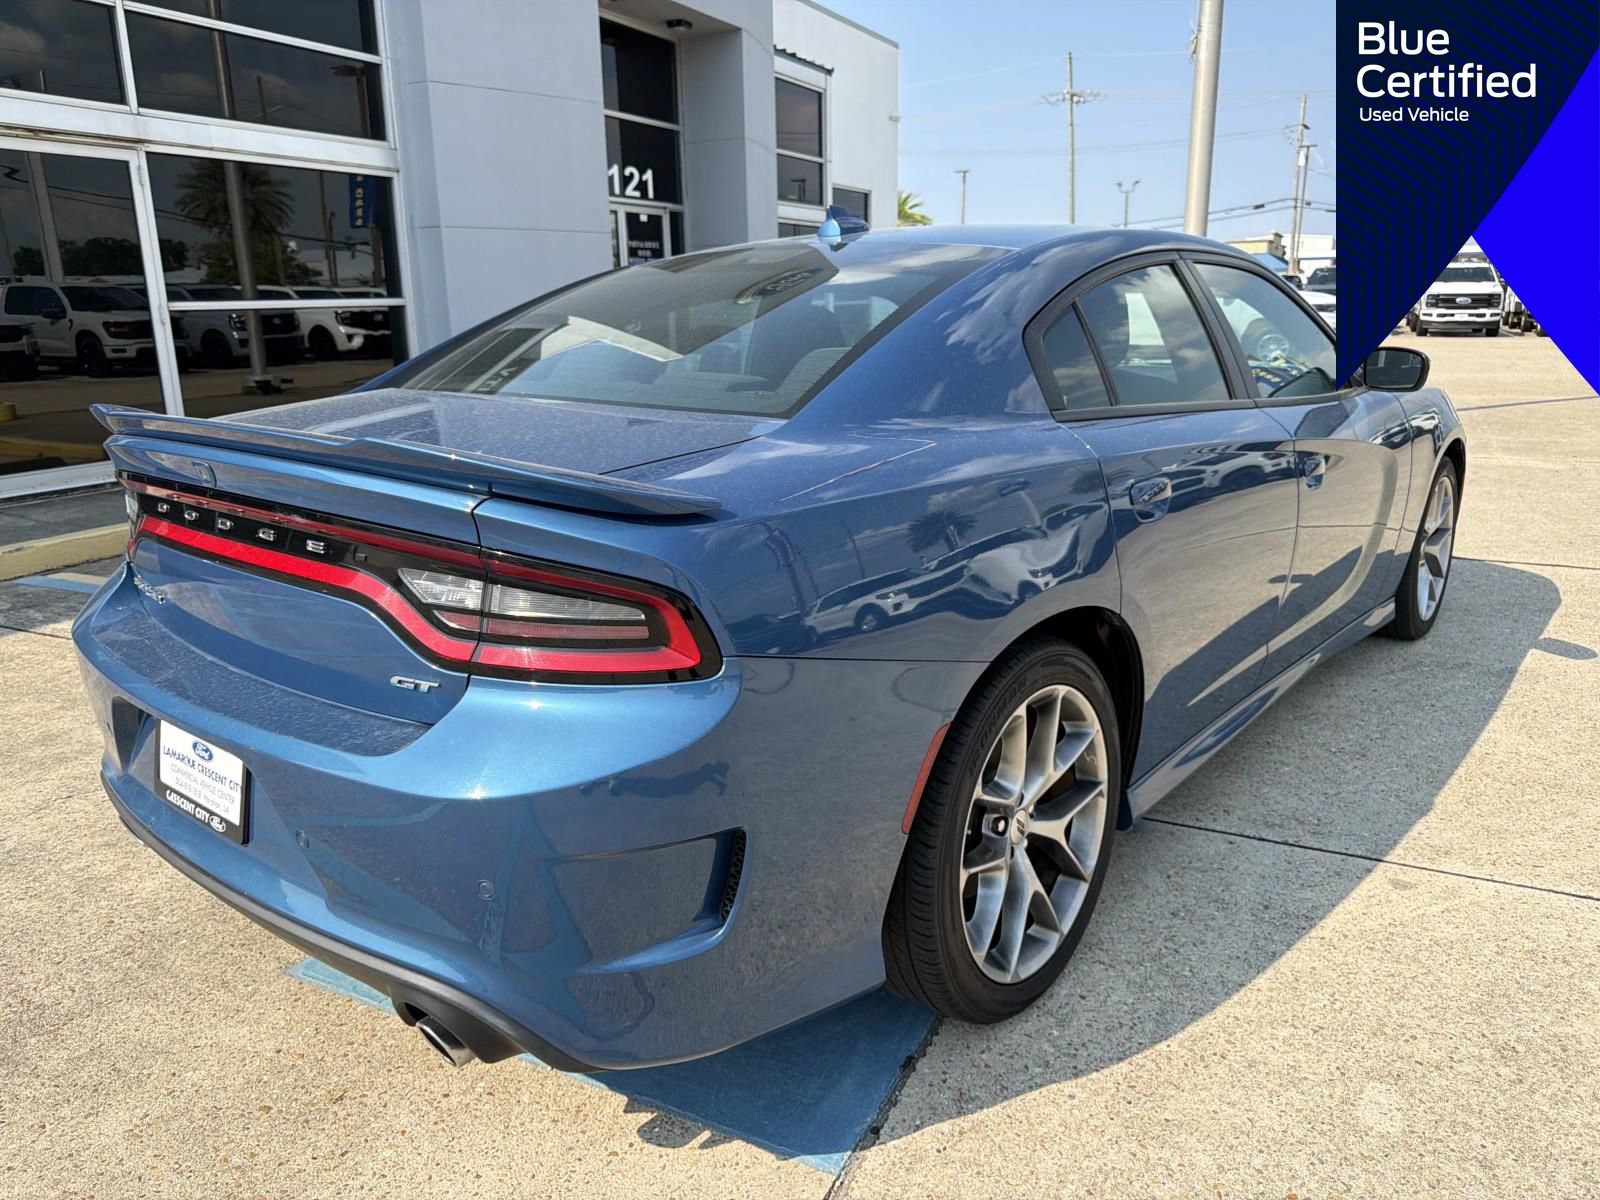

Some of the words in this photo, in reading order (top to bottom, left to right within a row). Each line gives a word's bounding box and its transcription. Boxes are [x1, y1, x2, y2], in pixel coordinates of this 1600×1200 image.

[607, 163, 655, 200] 121
[157, 502, 326, 554] DODGE
[390, 675, 441, 693] GT
[197, 763, 227, 787] CRESCENT
[195, 806, 210, 823] CITY
